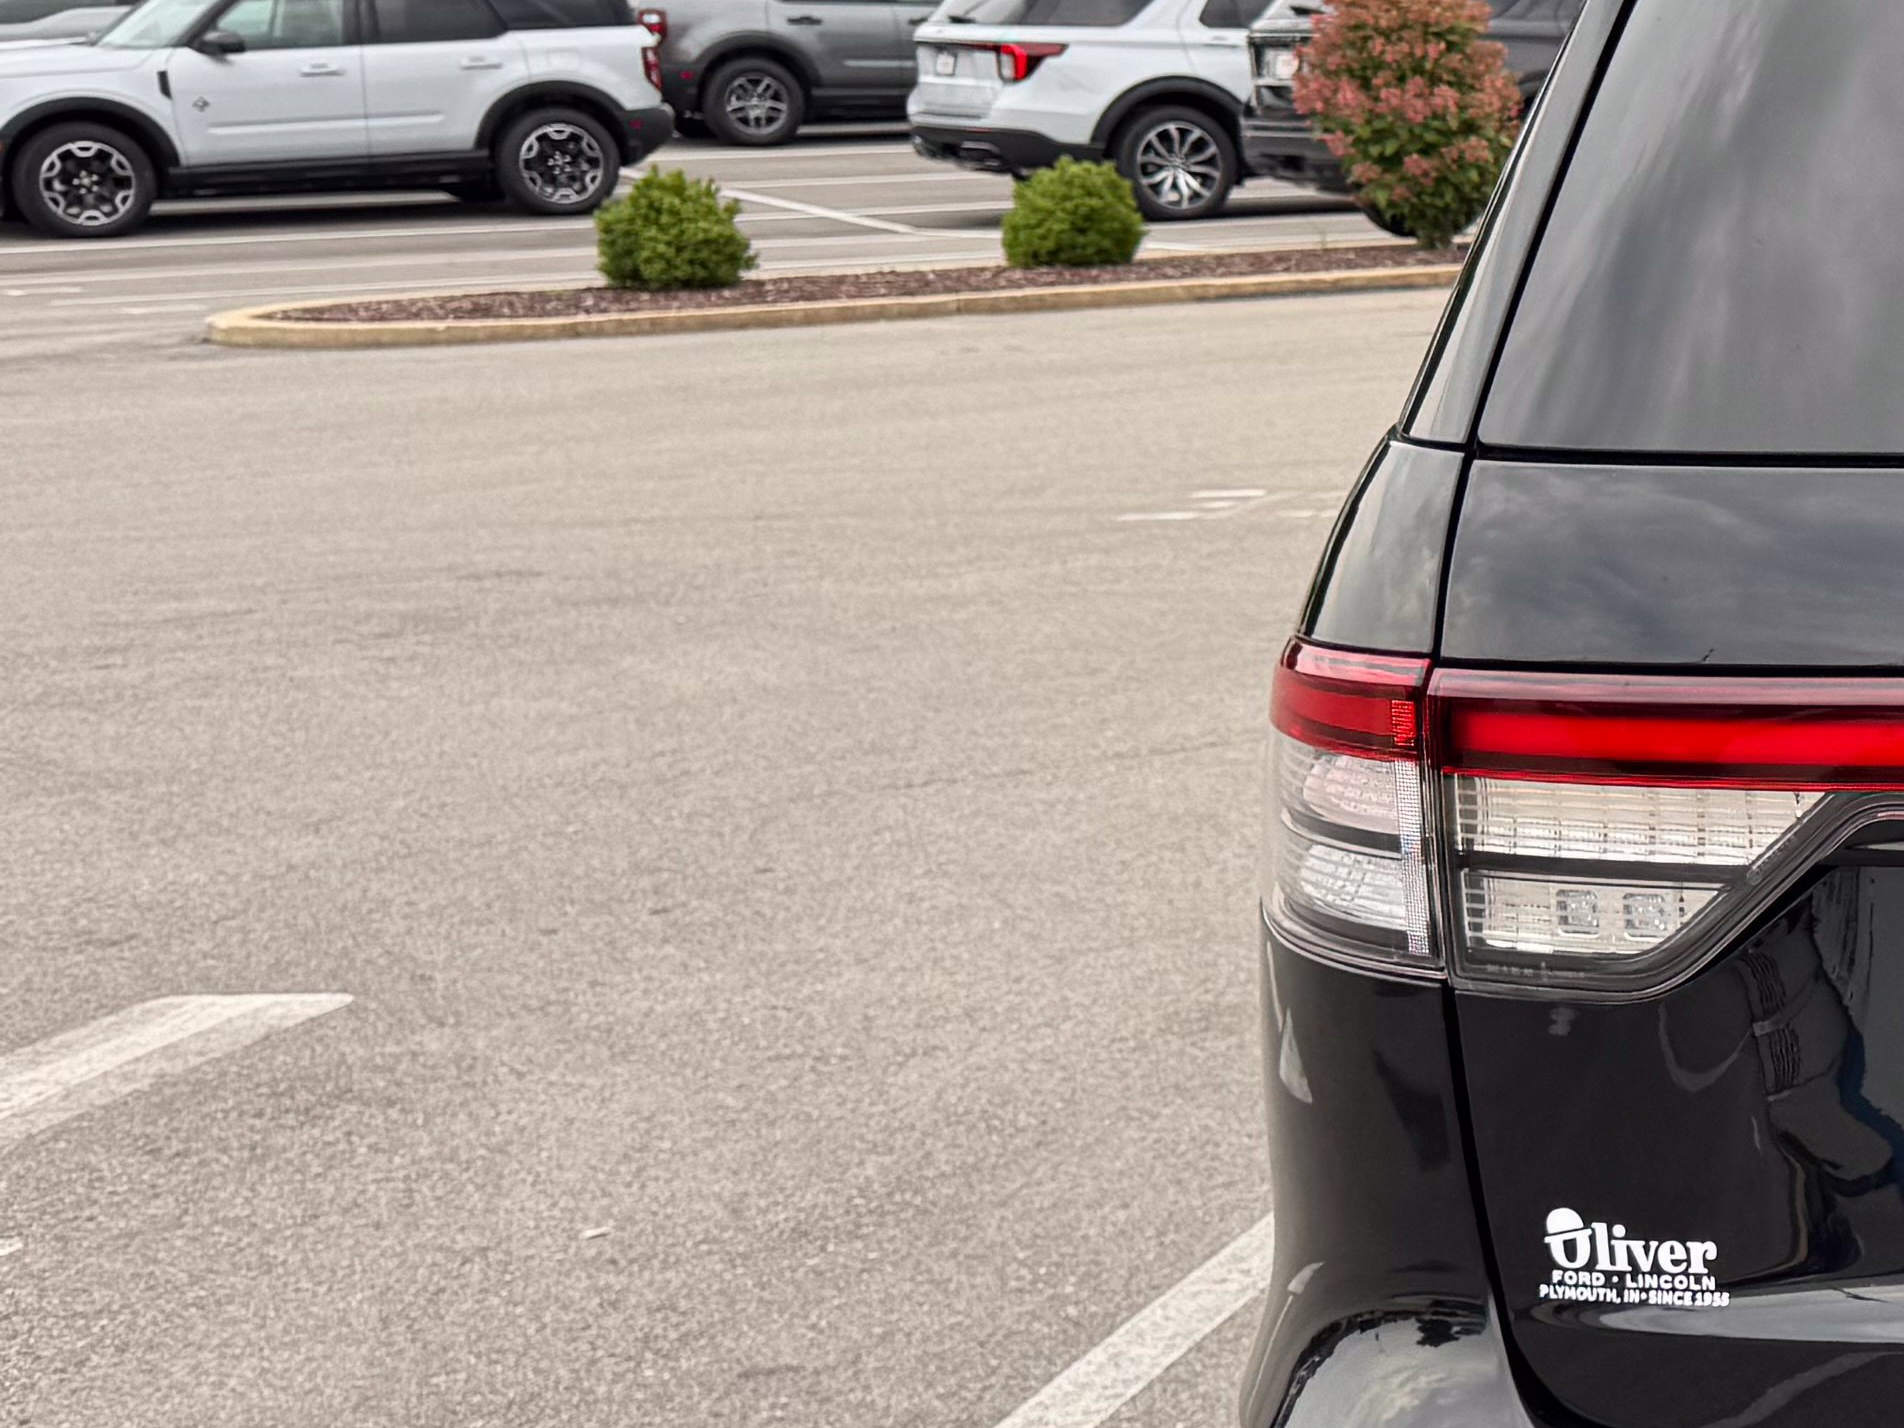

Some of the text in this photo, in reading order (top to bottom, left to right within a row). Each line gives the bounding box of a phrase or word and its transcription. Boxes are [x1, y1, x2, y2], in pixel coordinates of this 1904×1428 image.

[1544, 1207, 1718, 1274] Oliver
[1552, 1269, 1716, 1291] FORD LINCOLN
